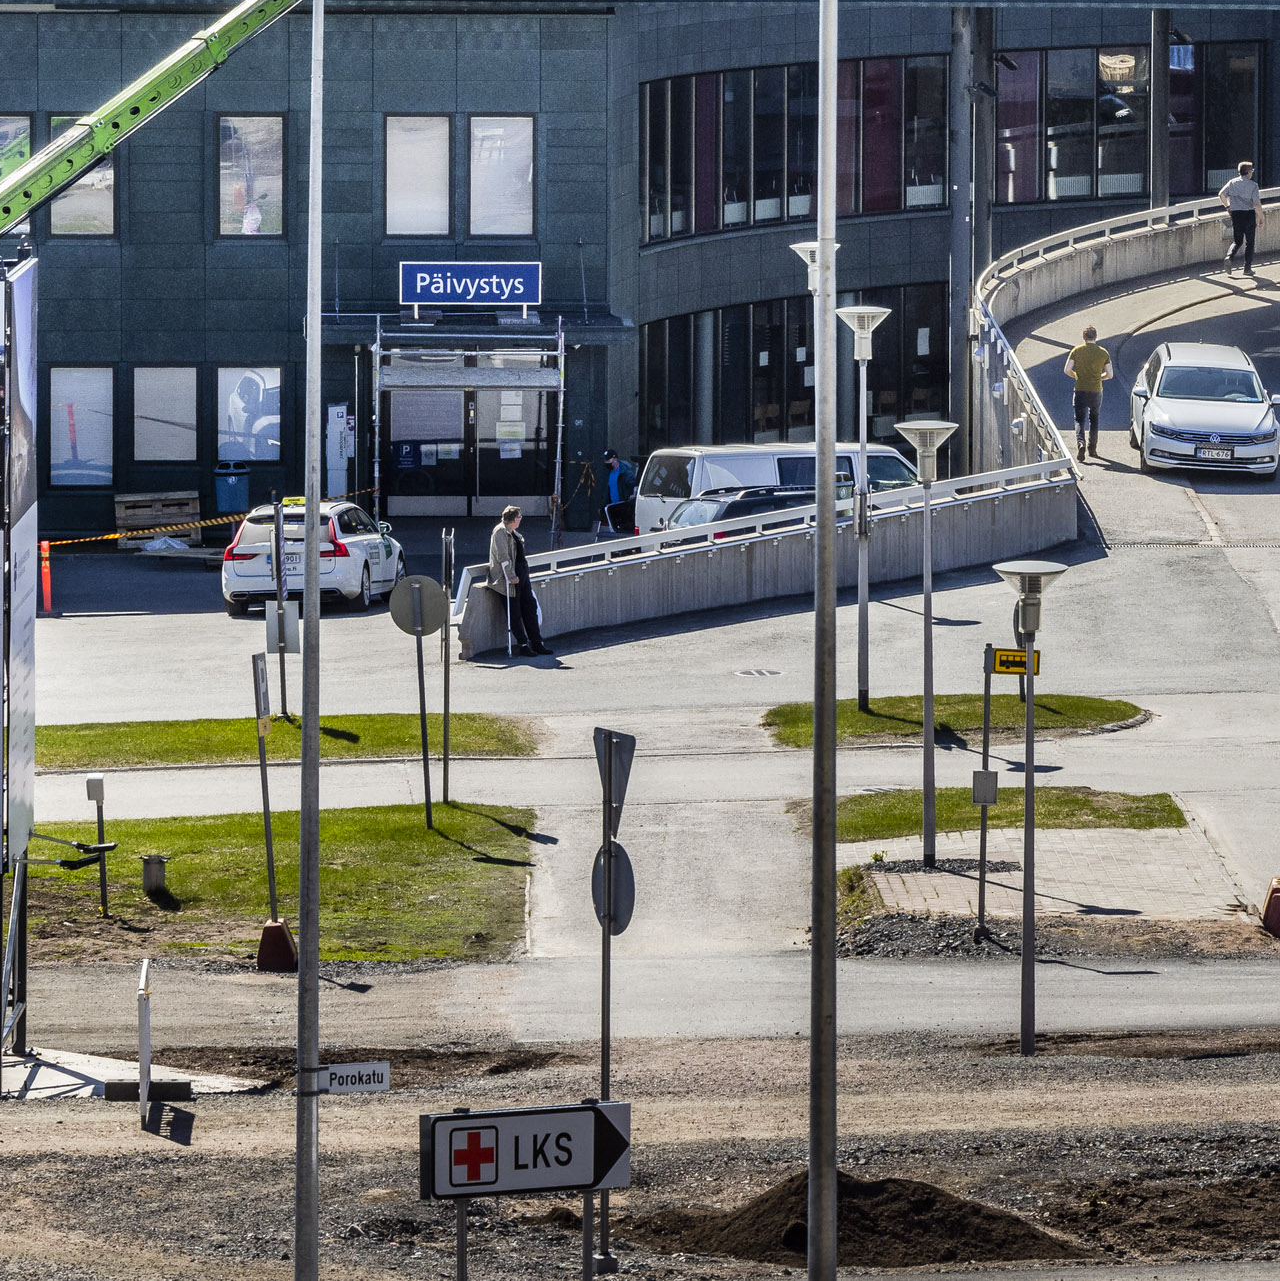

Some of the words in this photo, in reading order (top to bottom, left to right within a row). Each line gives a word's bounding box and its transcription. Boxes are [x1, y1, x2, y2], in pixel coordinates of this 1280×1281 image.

[416, 272, 524, 299] Päivystys
[328, 1070, 384, 1087] Porokatu
[514, 1132, 573, 1170] LKS
